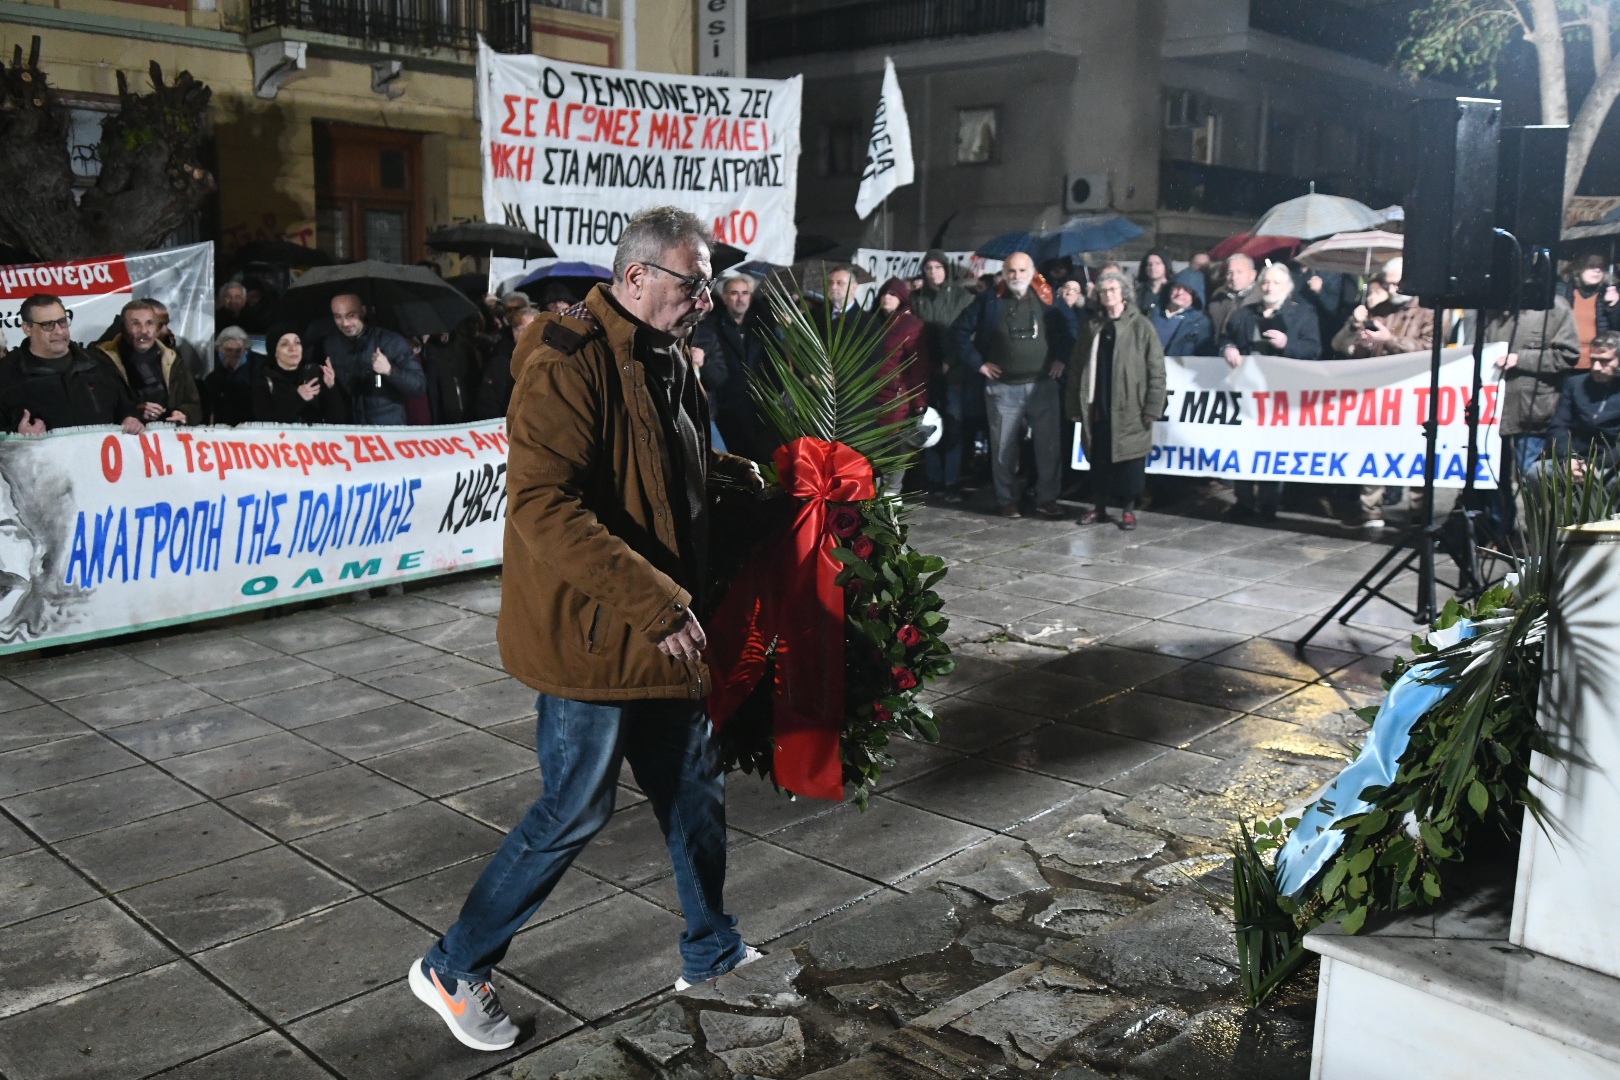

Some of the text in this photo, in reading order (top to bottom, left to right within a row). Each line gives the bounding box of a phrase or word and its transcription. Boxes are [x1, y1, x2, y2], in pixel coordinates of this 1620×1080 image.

[542, 66, 773, 119] Ο ΤΕΜΠΟΝΕΡΑΣ ΖΕΙ
[501, 94, 769, 151] ΣΕ ΑΓΩΝΕΣ ΜΑΣ ΚΑΛΕΙ
[542, 147, 579, 186] ΣΤΑ
[583, 151, 666, 190] ΜΠΛΟΚΑ
[672, 155, 706, 191] ΤΗΣ
[0, 260, 114, 294] μπονέρα
[1179, 390, 1243, 426] ΜΑΣ
[1252, 390, 1290, 427] ΤΑ
[1299, 388, 1403, 427] ΚΕΡΔΗ
[1413, 384, 1499, 426] ΤΟΥΣ
[101, 434, 123, 484] Ο
[139, 433, 173, 478] Ν.
[176, 432, 352, 481] Τεμπονέρας
[344, 435, 395, 464] ΖΕΙ
[394, 436, 476, 459] στους
[1146, 445, 1241, 474] ΡΤΗΜΑ
[1251, 451, 1350, 477] ΠΕΣΕΚ
[65, 494, 226, 589] ΑΝΑΤΡΟΠΗ
[235, 490, 288, 565] ΤΗΣ
[287, 476, 422, 559] ΠΟΛΙΤΙΚΗΣ
[241, 550, 425, 596] ΟΛΜΕ
